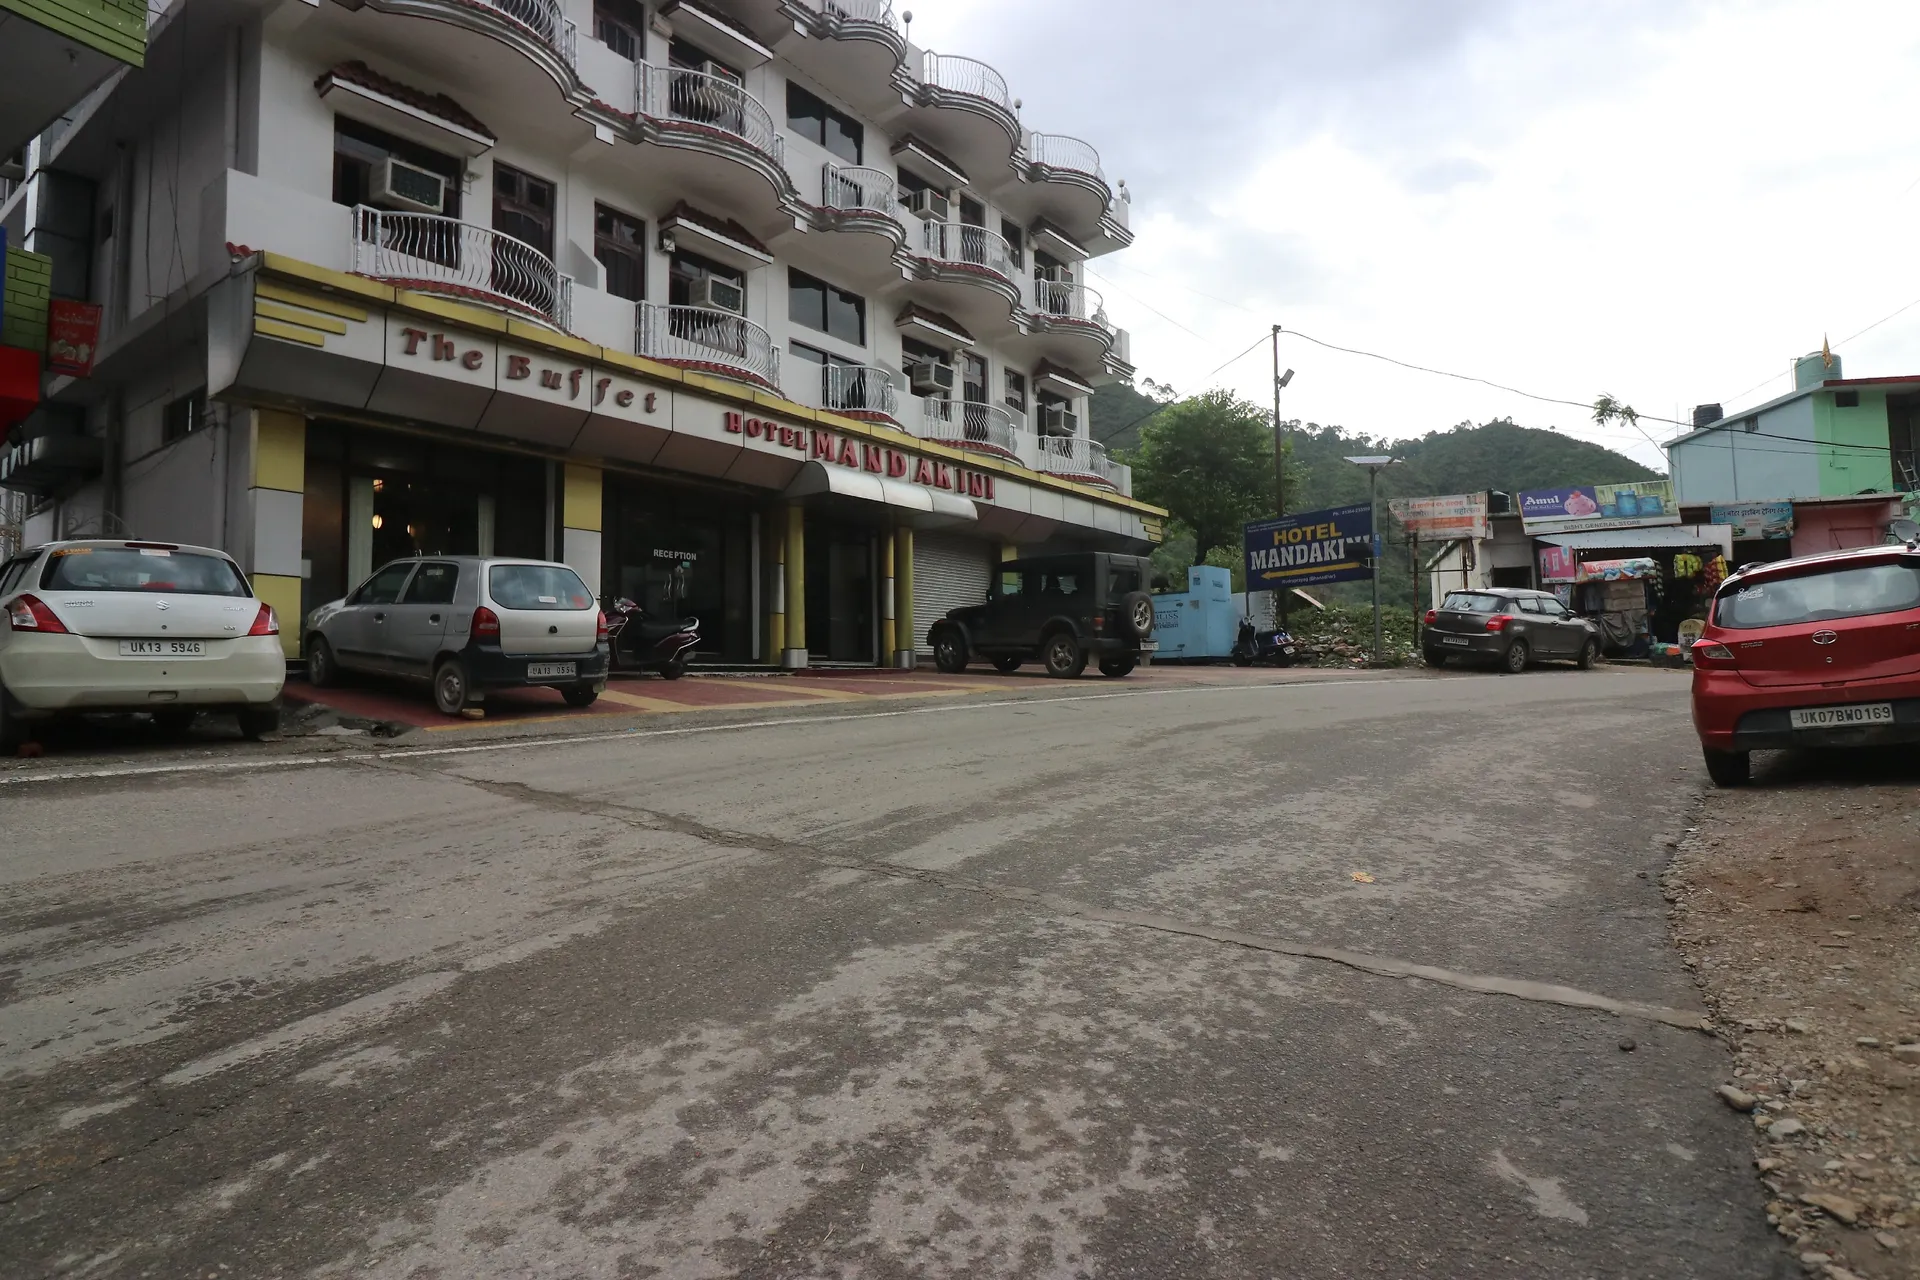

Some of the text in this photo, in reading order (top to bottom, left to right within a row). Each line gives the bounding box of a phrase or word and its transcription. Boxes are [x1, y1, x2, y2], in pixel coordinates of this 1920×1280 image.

[401, 327, 657, 414] The Buffet
[724, 411, 996, 500] HOTEL MANDAKINI
[1524, 495, 1560, 506] Amul
[1563, 519, 1641, 531] BISHT GENERAL STORE
[1273, 522, 1343, 546] HOTEL
[653, 548, 697, 561] RECEPTION
[130, 642, 200, 653] UK13 5946
[544, 667, 551, 675] 13
[1800, 706, 1892, 724] UK07BW0169
